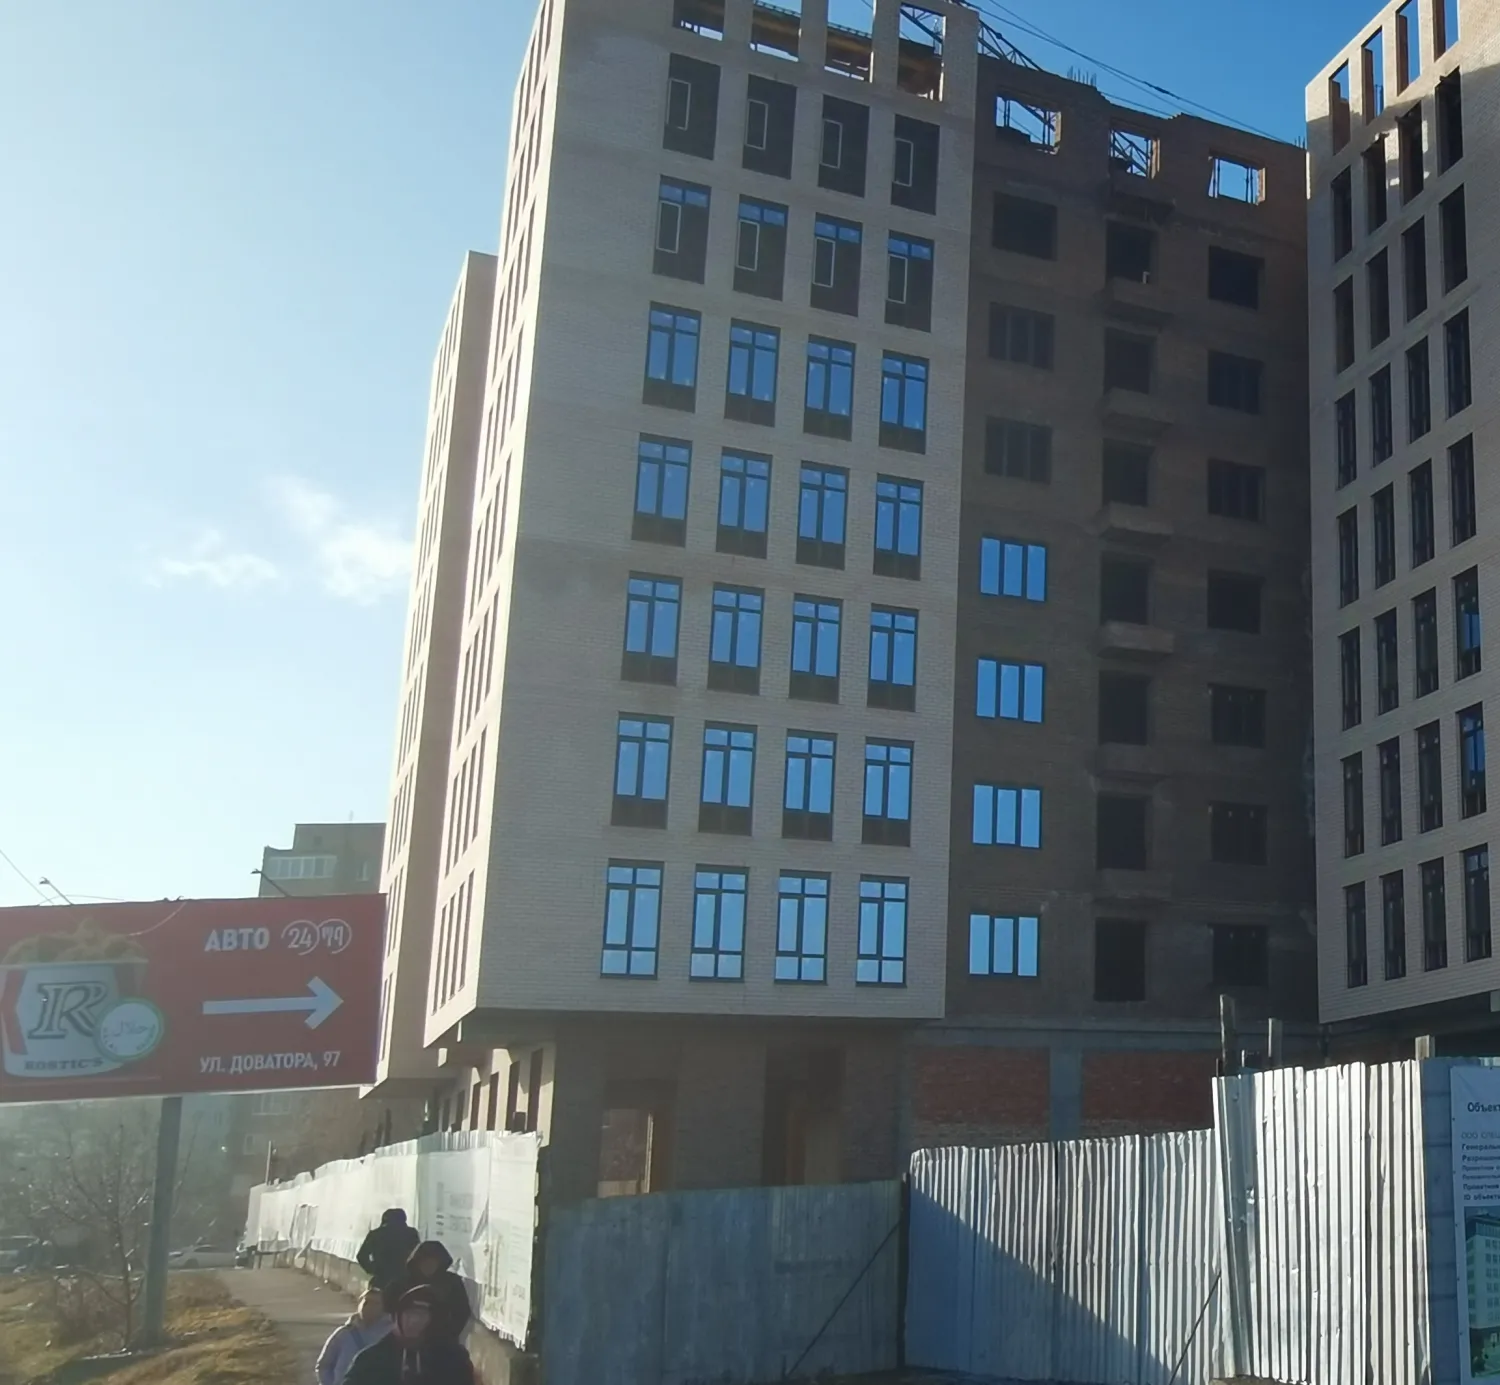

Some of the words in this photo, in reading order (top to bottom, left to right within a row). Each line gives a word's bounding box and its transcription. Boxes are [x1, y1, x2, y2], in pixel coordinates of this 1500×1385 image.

[204, 927, 270, 952] АВТО
[287, 926, 312, 949] 24
[199, 1056, 225, 1073] УЛ.
[229, 1052, 318, 1075] ДОВАТОРА,
[323, 1050, 341, 1068] 97
